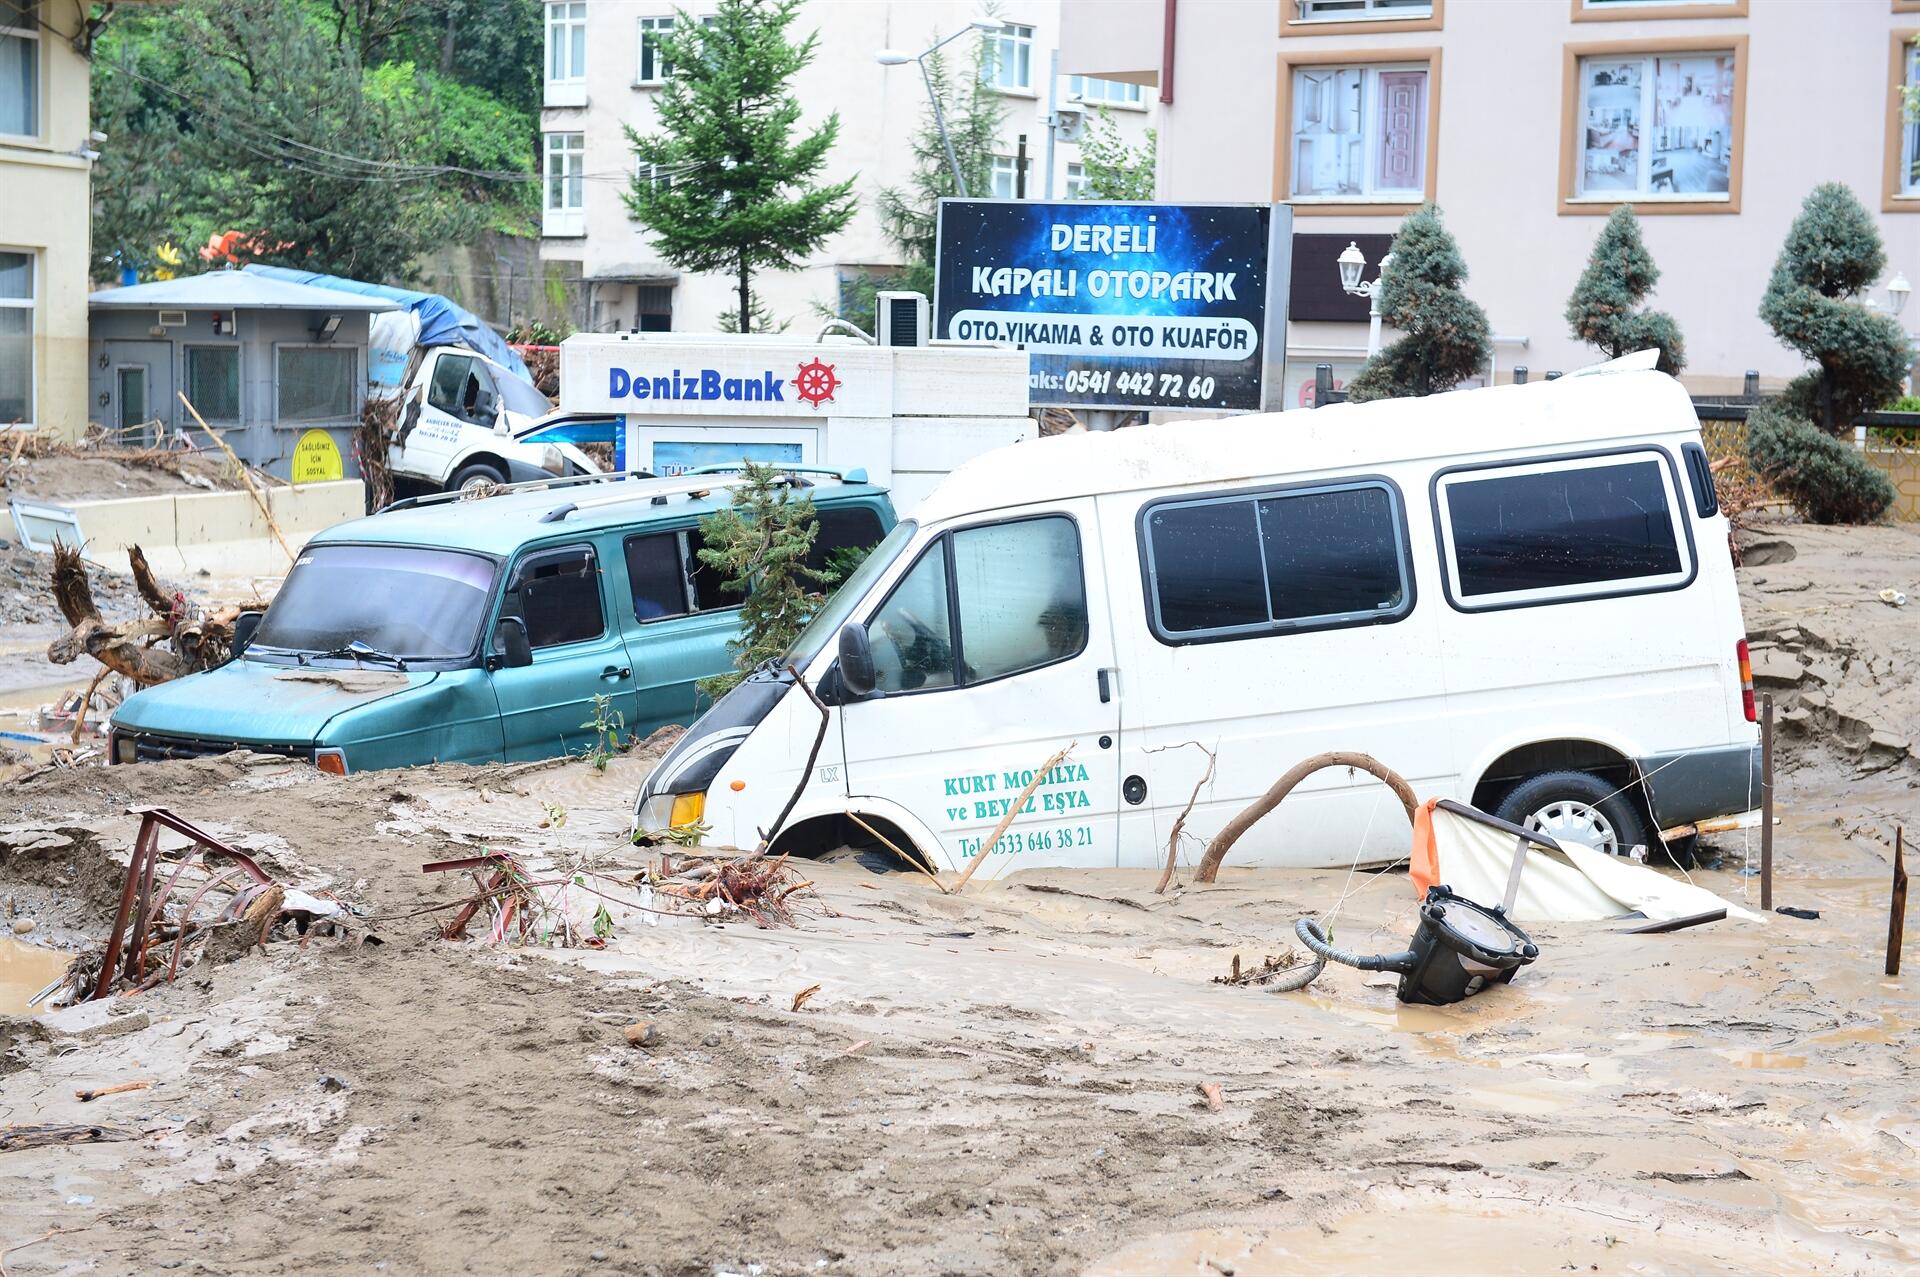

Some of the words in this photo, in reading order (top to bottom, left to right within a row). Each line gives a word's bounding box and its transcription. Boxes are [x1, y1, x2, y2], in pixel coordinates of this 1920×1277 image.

[1051, 215, 1158, 256] DERELİ
[971, 265, 1077, 299] KAPALI
[1087, 269, 1238, 304] OTOPARK
[958, 319, 999, 341] OTO
[1006, 322, 1082, 345] YIKAMA
[1089, 325, 1104, 346] &
[1111, 325, 1155, 348] OTO
[1162, 323, 1248, 350] KUAFÖR
[609, 367, 785, 402] DenizBank
[1116, 372, 1152, 396] 442
[1158, 374, 1181, 398] 72
[1188, 375, 1216, 400] 60
[306, 467, 326, 476] SOSYAL
[944, 774, 997, 796] KURT
[946, 806, 968, 822] ve
[1043, 789, 1091, 815] EŞYA
[991, 833, 1023, 855] 0533
[1028, 830, 1052, 851] 646
[1056, 828, 1073, 848] 38
[1077, 826, 1093, 846] 21
